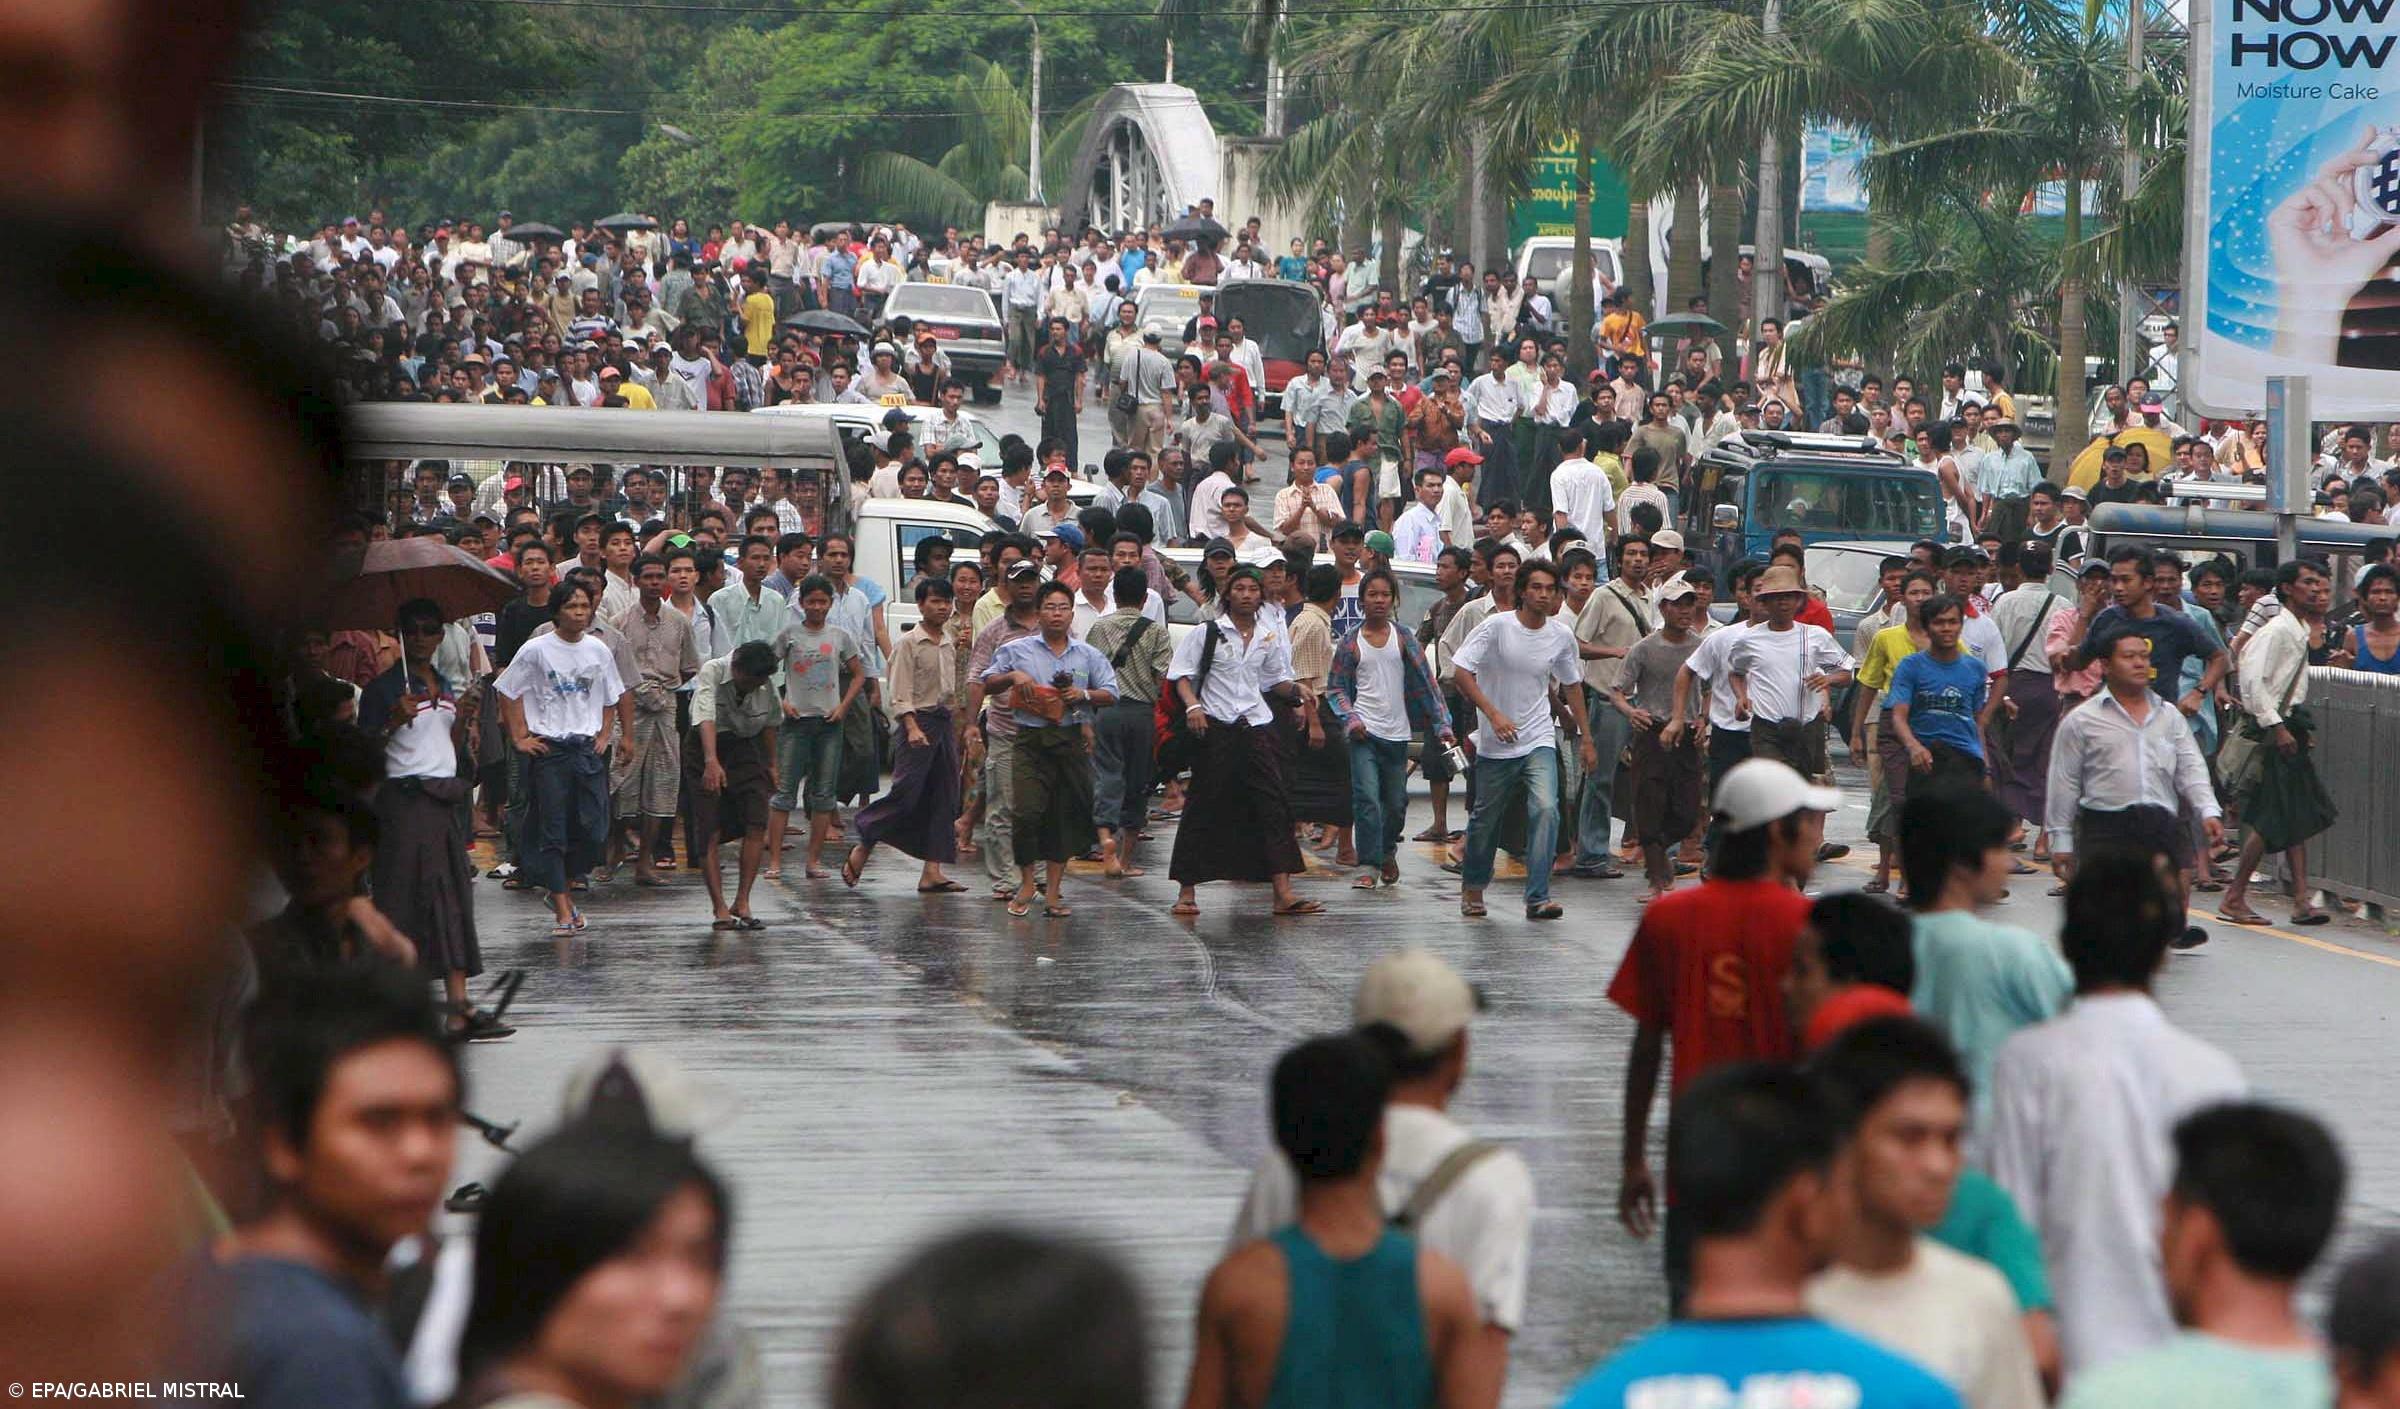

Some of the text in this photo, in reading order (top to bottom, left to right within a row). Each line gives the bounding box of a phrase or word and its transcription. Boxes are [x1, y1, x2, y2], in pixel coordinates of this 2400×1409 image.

[2232, 0, 2396, 26] NOW
[2231, 31, 2398, 70] HOW
[2237, 83, 2379, 100] Moisture Cake
